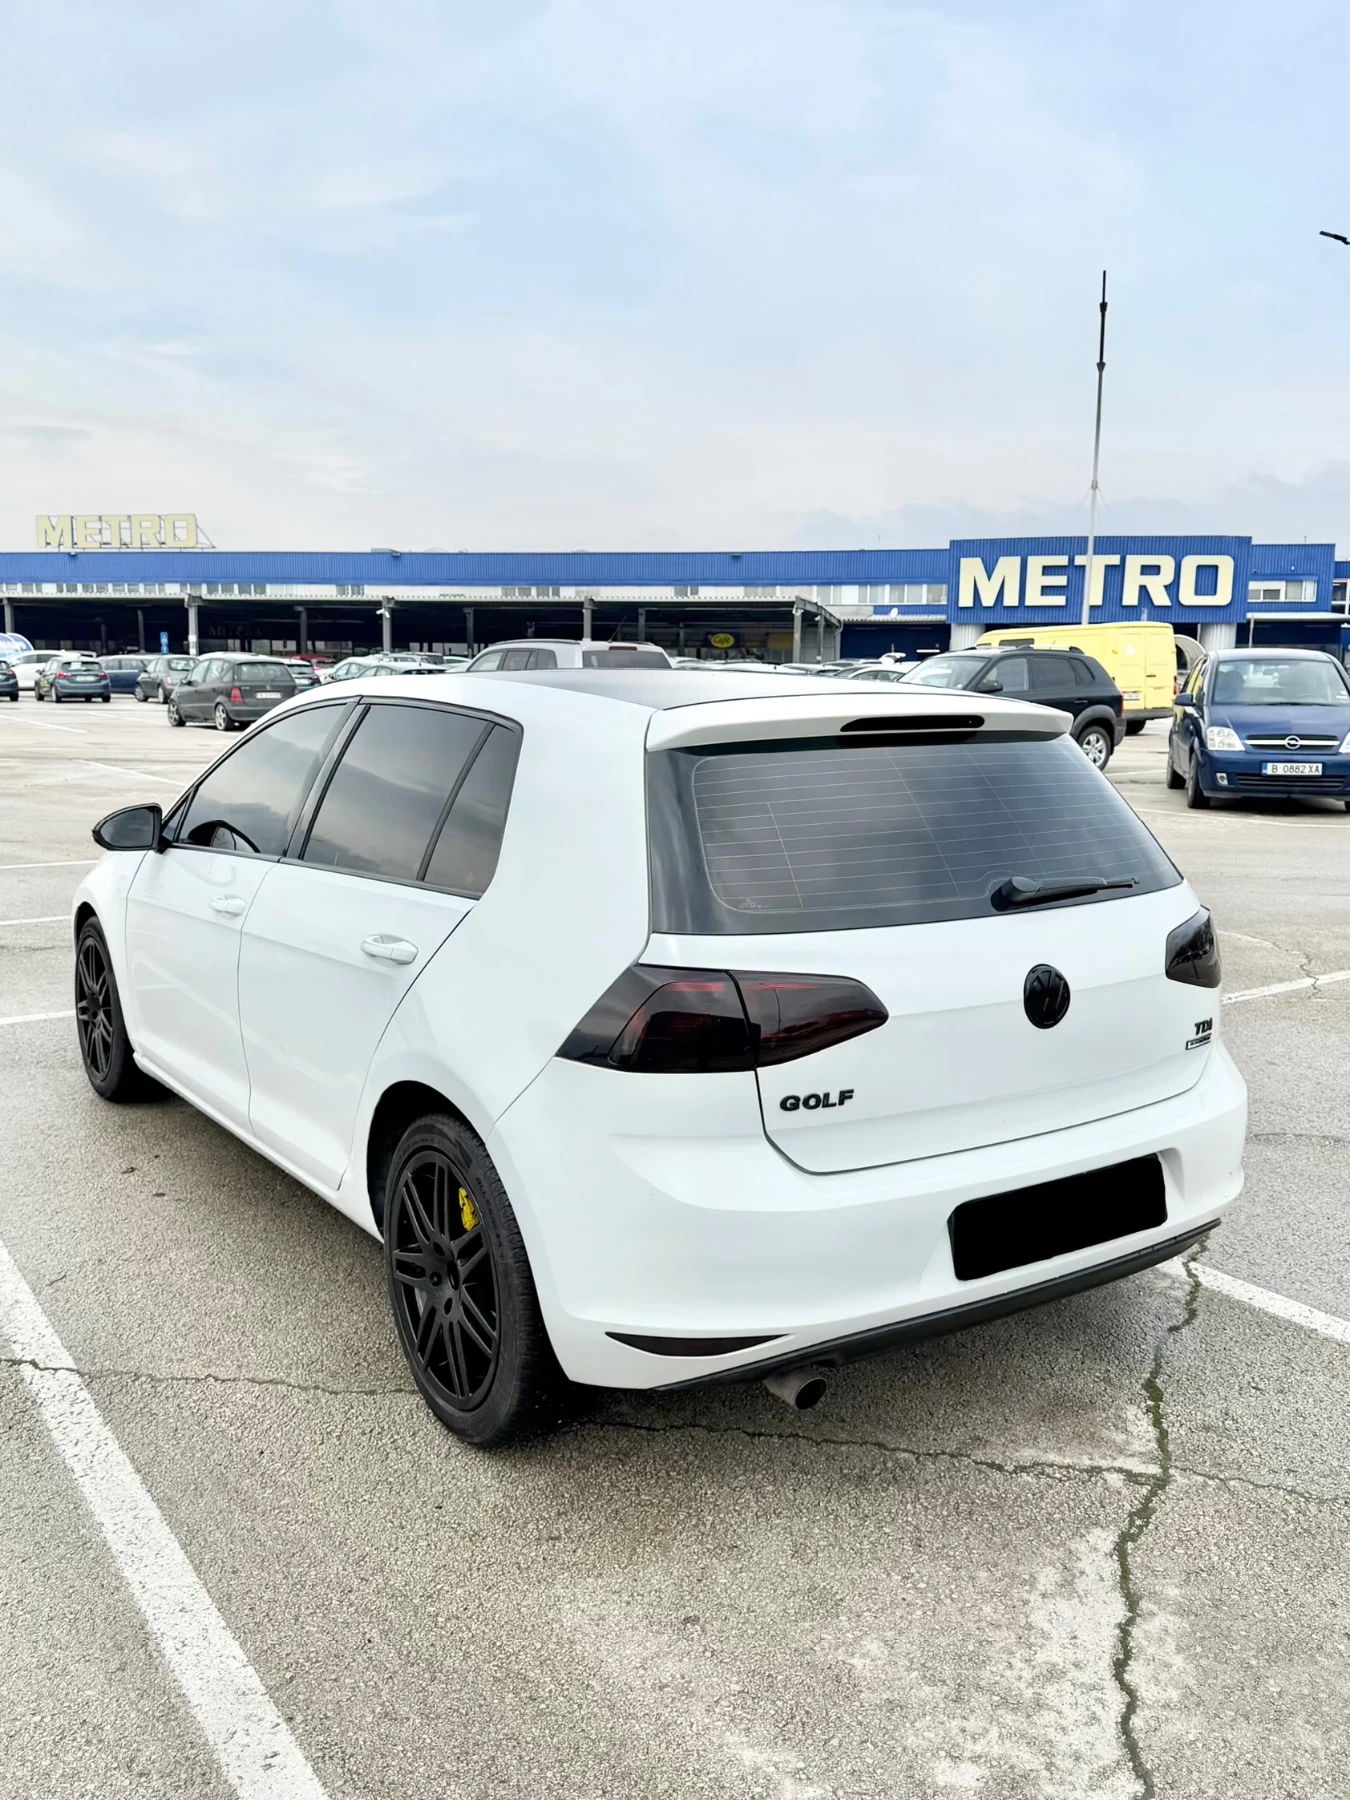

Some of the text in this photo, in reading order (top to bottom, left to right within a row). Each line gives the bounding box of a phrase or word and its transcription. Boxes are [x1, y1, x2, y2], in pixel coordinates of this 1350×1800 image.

[36, 513, 198, 548] METRO
[958, 554, 1234, 608] METRO
[1271, 764, 1320, 774] B 0882 XA
[779, 1088, 854, 1112] GOLF
